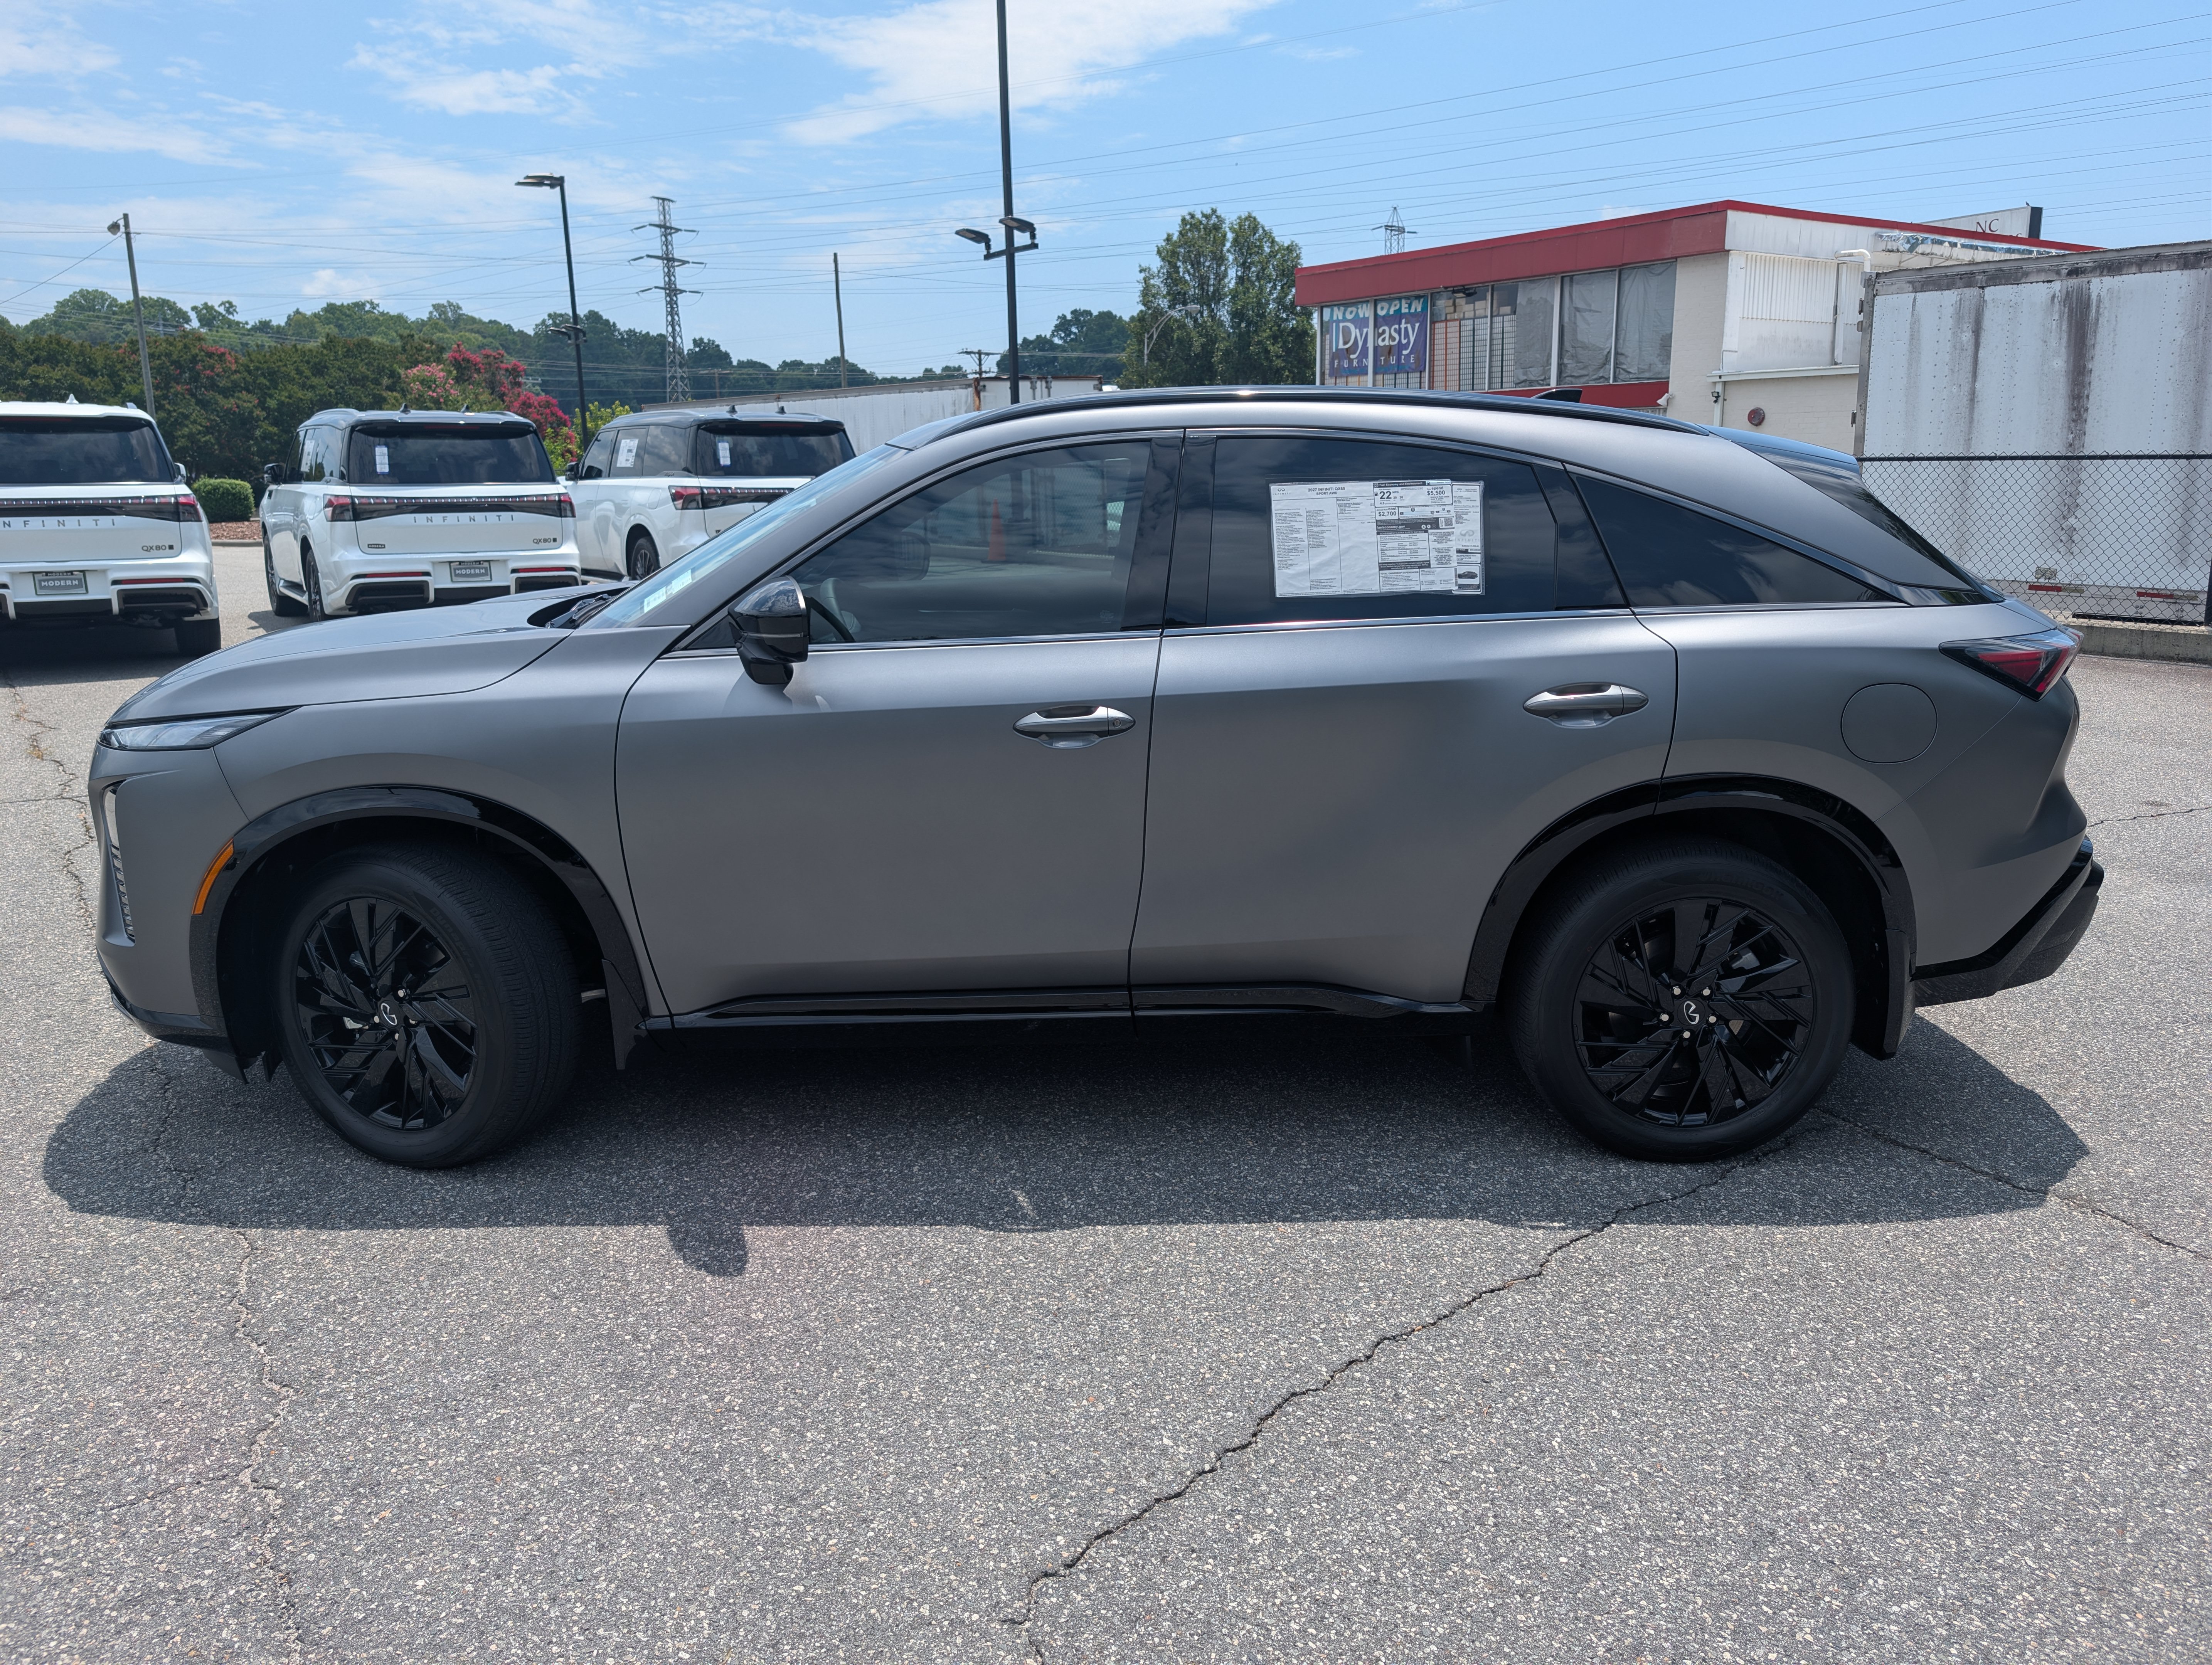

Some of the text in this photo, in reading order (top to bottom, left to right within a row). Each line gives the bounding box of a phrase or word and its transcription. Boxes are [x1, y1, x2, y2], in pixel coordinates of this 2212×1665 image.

[1976, 219, 1999, 233] NC
[1333, 298, 1424, 320] NOW OPEN
[1338, 318, 1420, 359] Dynasty
[1334, 355, 1415, 368] FURNTURE
[1379, 491, 1392, 500] 22
[414, 515, 514, 523] INFINITI
